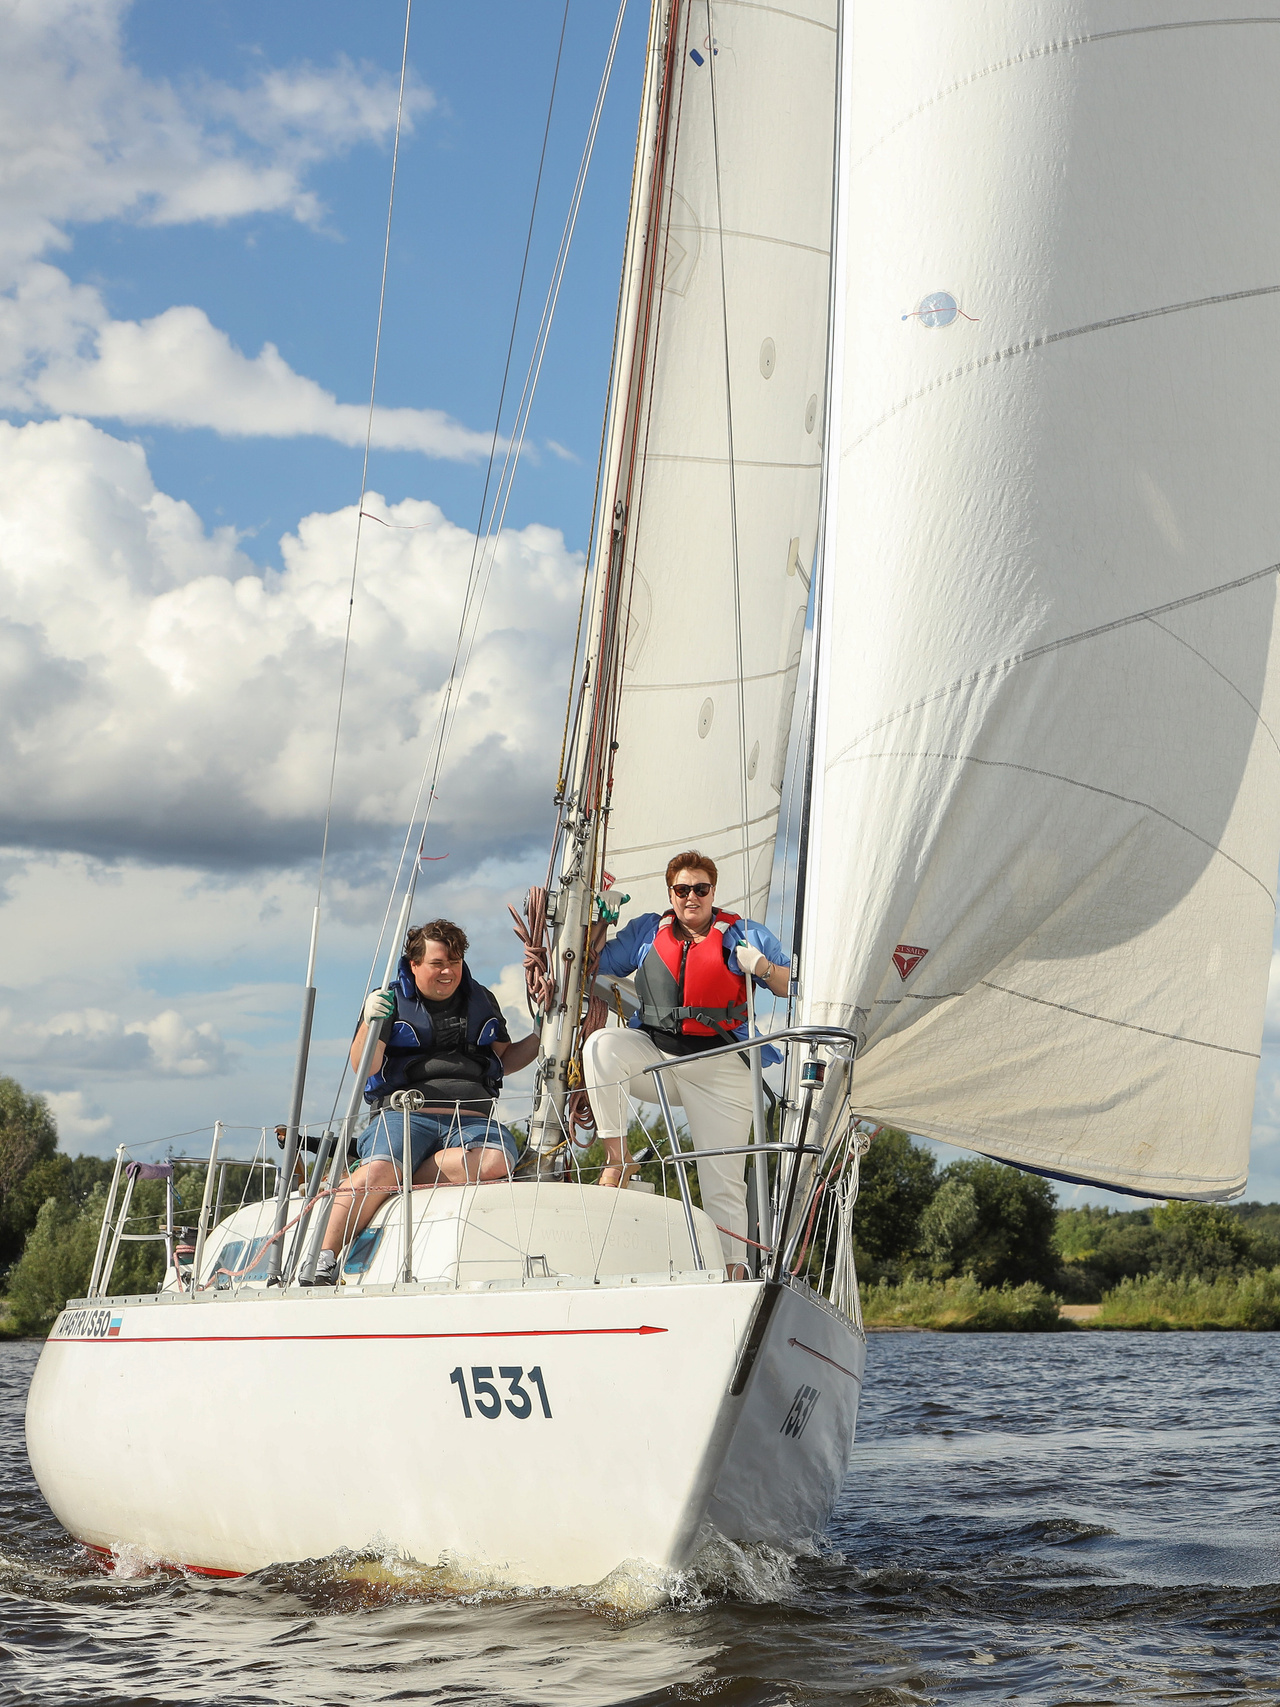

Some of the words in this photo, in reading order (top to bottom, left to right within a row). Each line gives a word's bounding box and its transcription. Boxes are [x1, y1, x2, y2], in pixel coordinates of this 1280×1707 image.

[540, 1228, 659, 1253] www.carer30.ru
[449, 1365, 553, 1420] 1531
[779, 1384, 822, 1440] 1531
